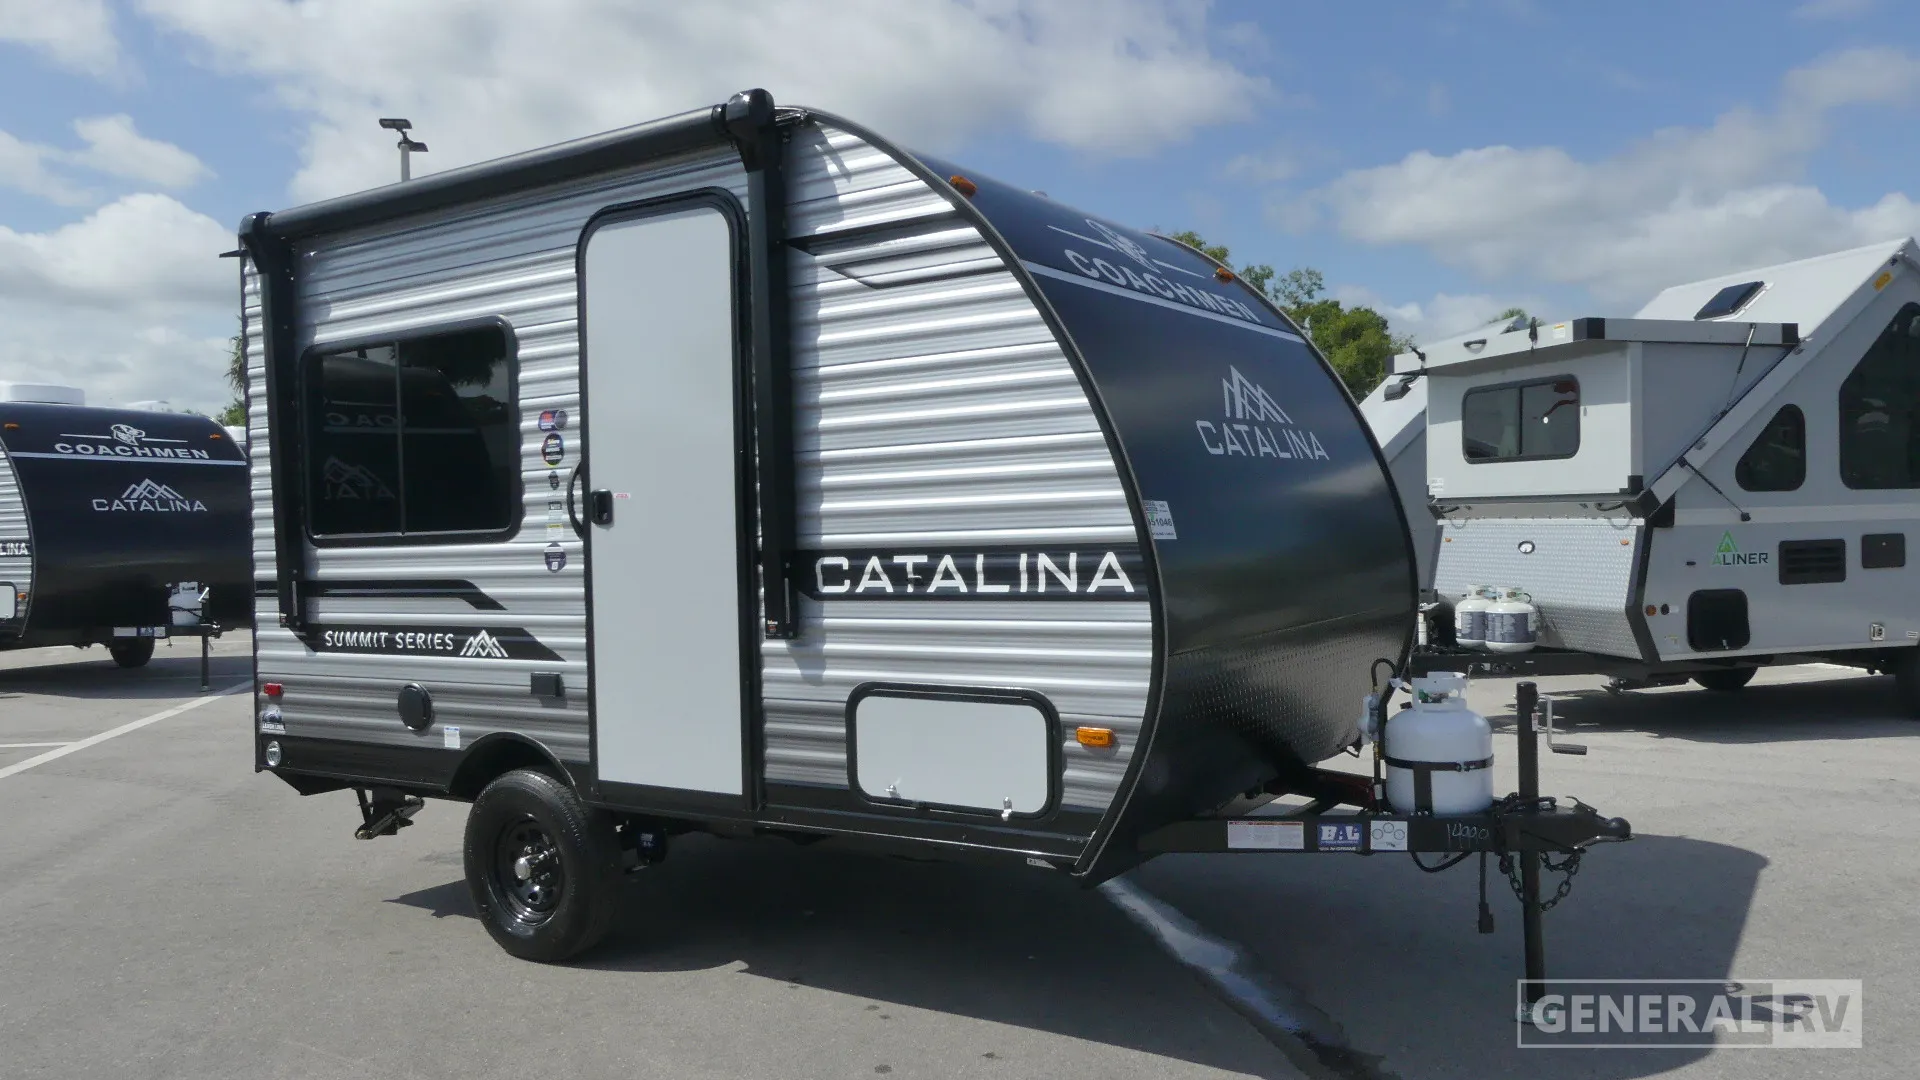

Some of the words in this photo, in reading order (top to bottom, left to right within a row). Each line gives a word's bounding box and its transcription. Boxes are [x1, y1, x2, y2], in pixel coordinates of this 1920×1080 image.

[1064, 249, 1262, 323] COACHMEN
[1196, 420, 1330, 460] CATALINA
[54, 443, 210, 460] COACHMEN
[92, 499, 208, 512] CATALINA
[815, 551, 1135, 593] CATALINA
[324, 630, 388, 648] SUMMIT
[395, 633, 454, 650] SERIES
[1320, 825, 1360, 841] BAL
